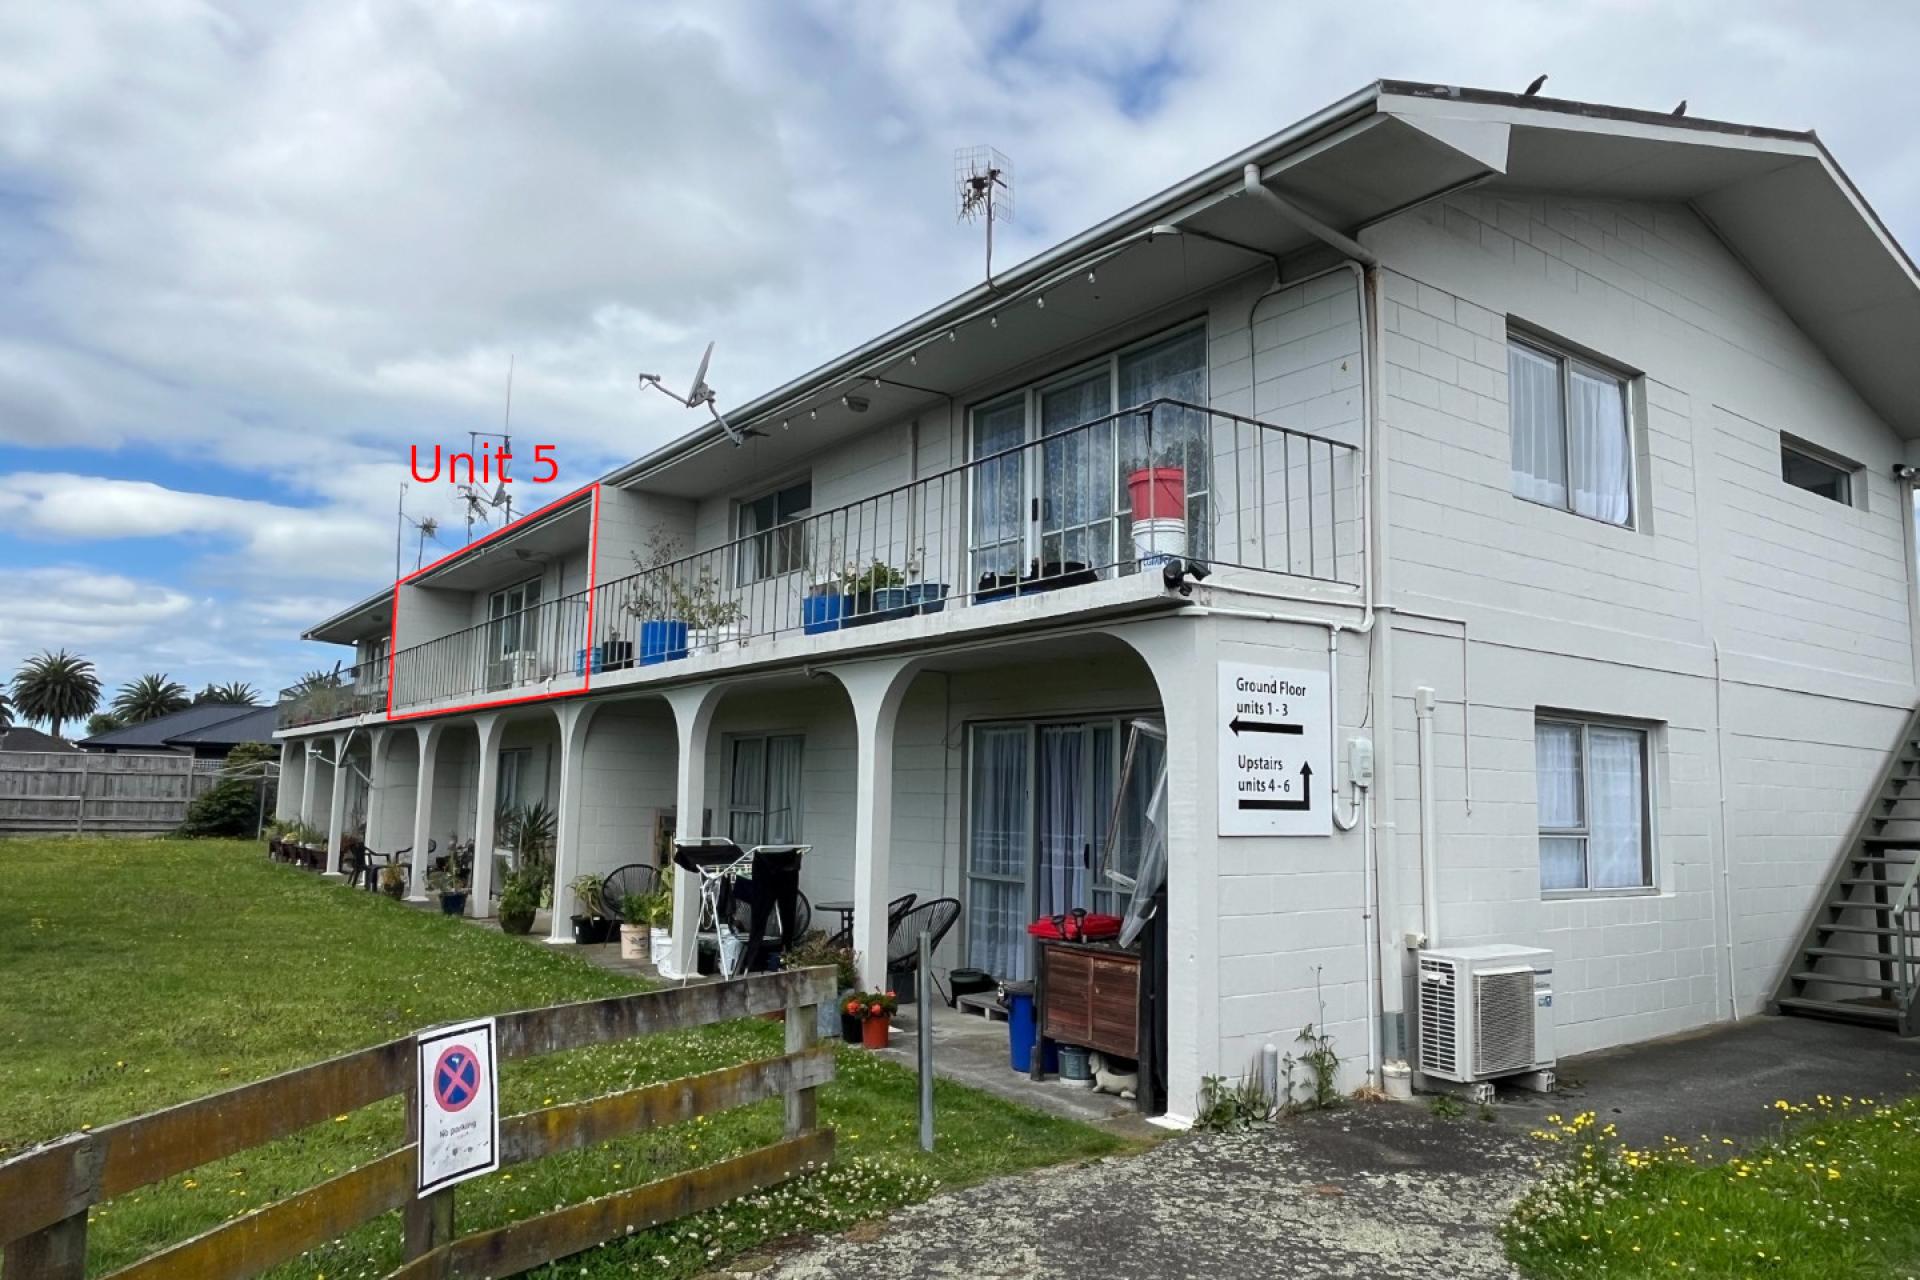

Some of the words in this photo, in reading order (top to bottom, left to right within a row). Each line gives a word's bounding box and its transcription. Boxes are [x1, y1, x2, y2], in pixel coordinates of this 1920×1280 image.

[1236, 677, 1277, 694] Ground
[1279, 680, 1306, 696] Floor
[1236, 700, 1264, 715] units
[1267, 702, 1272, 715] 1
[1282, 703, 1288, 716] 3
[1238, 754, 1283, 772] Upstairs
[1238, 777, 1266, 792] units
[1268, 778, 1275, 792] 4
[1283, 779, 1290, 792] 6
[439, 1129, 449, 1138] No
[450, 1120, 477, 1136] parking
